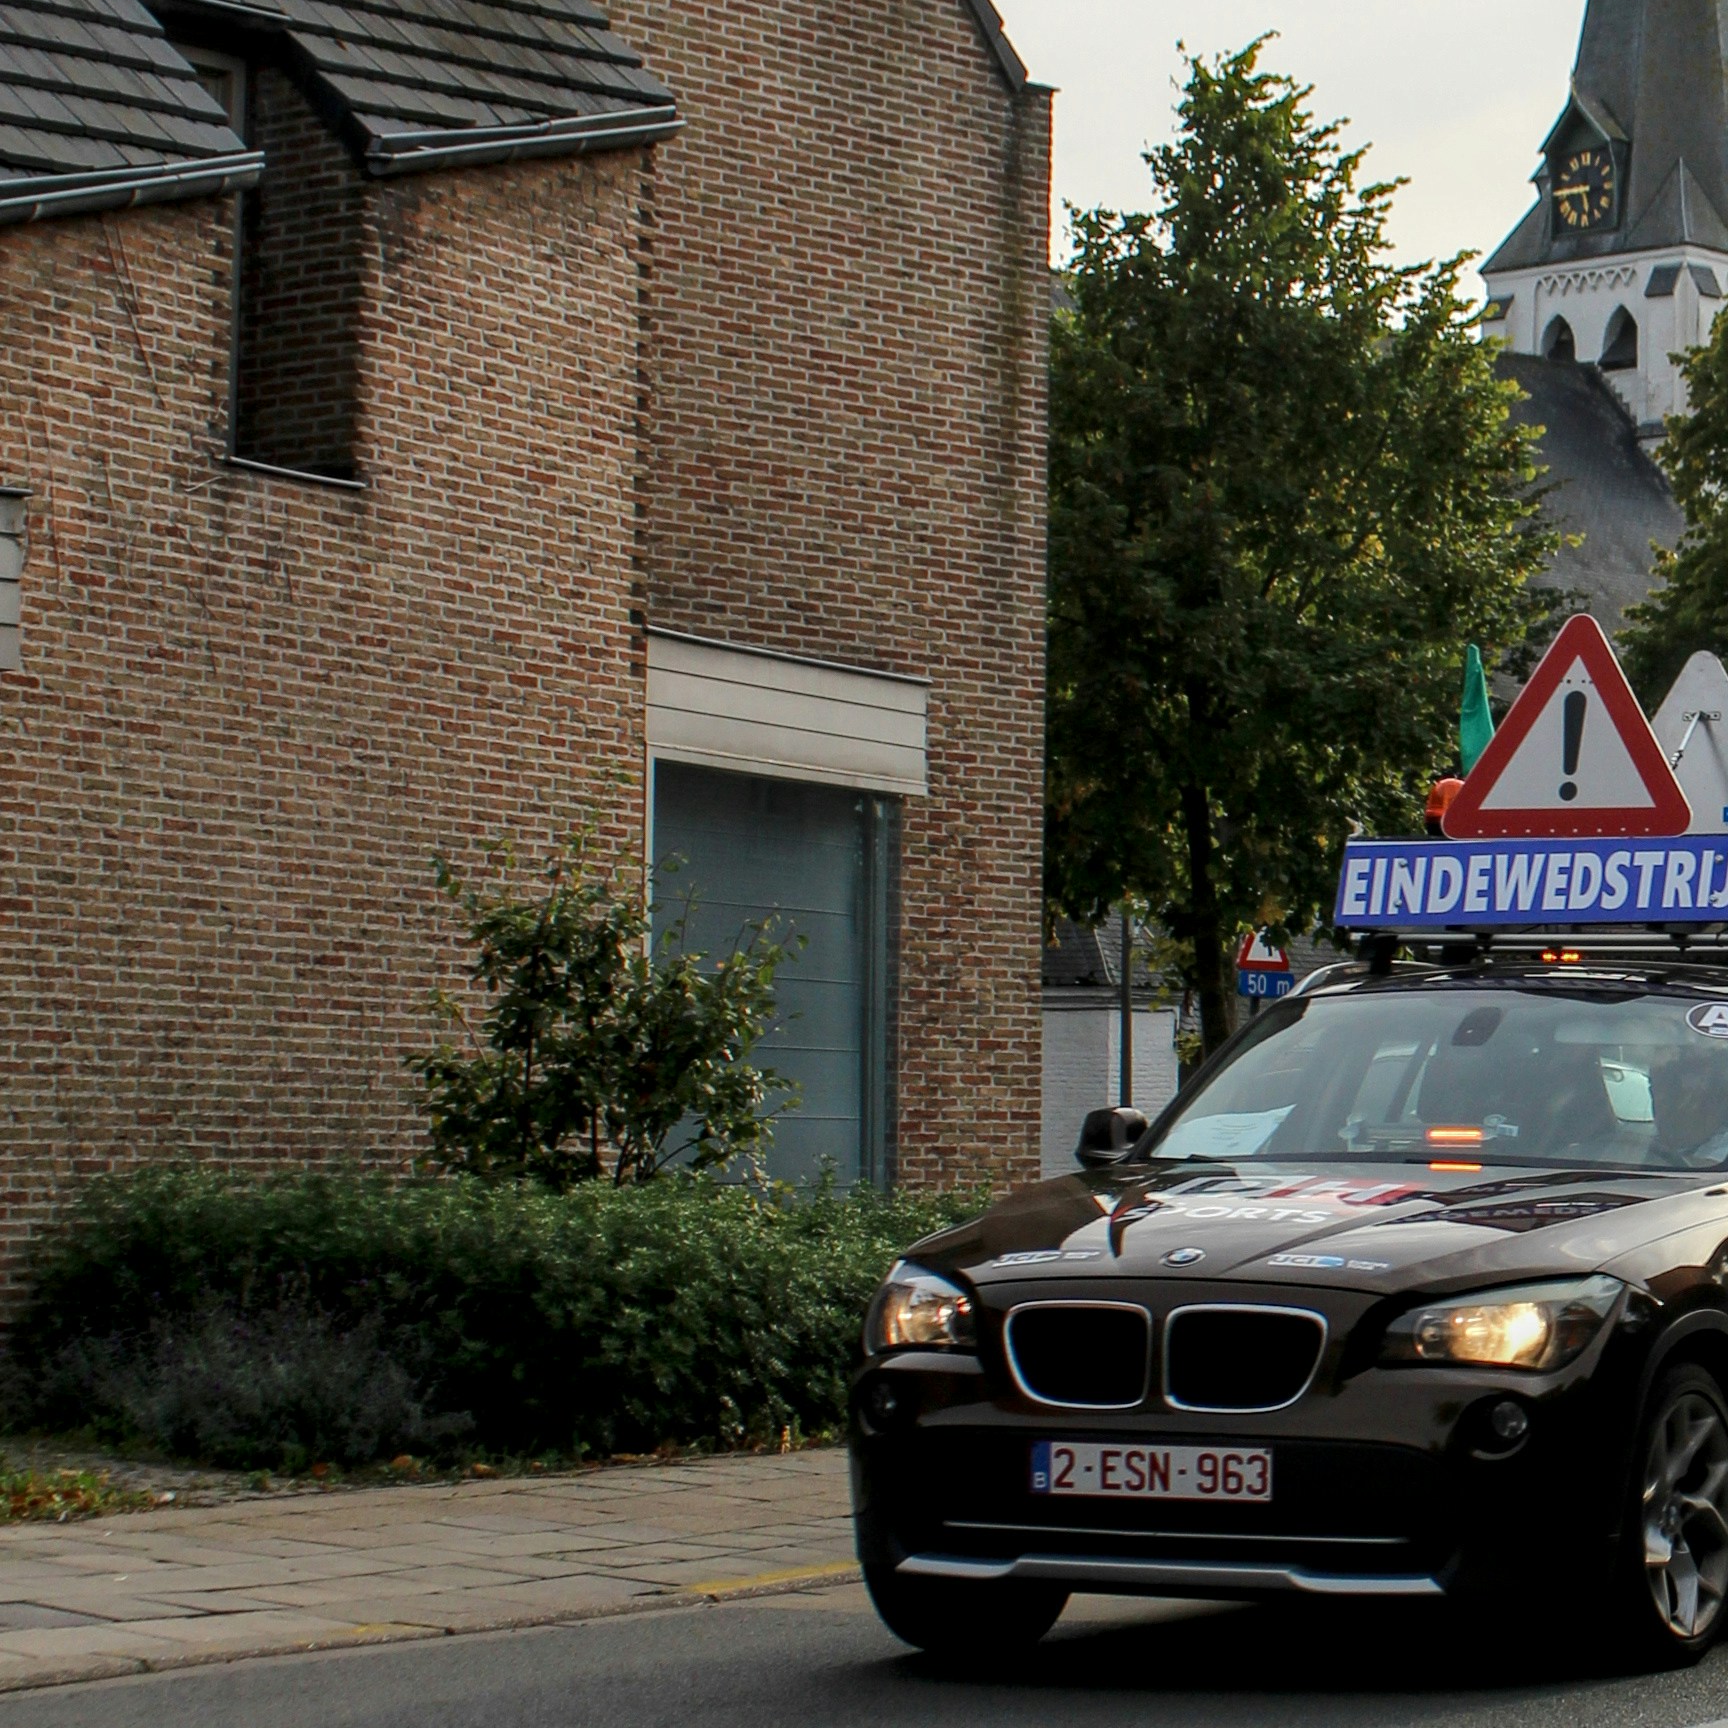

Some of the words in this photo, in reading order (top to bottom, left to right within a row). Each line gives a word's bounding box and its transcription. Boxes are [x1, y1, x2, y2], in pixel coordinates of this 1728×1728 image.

[1248, 974, 1267, 994] 50
[1276, 980, 1290, 995] m
[1117, 1205, 1332, 1223] SPORTS
[1033, 1472, 1047, 1488] B
[1053, 1447, 1268, 1495] 2-ESN-963
